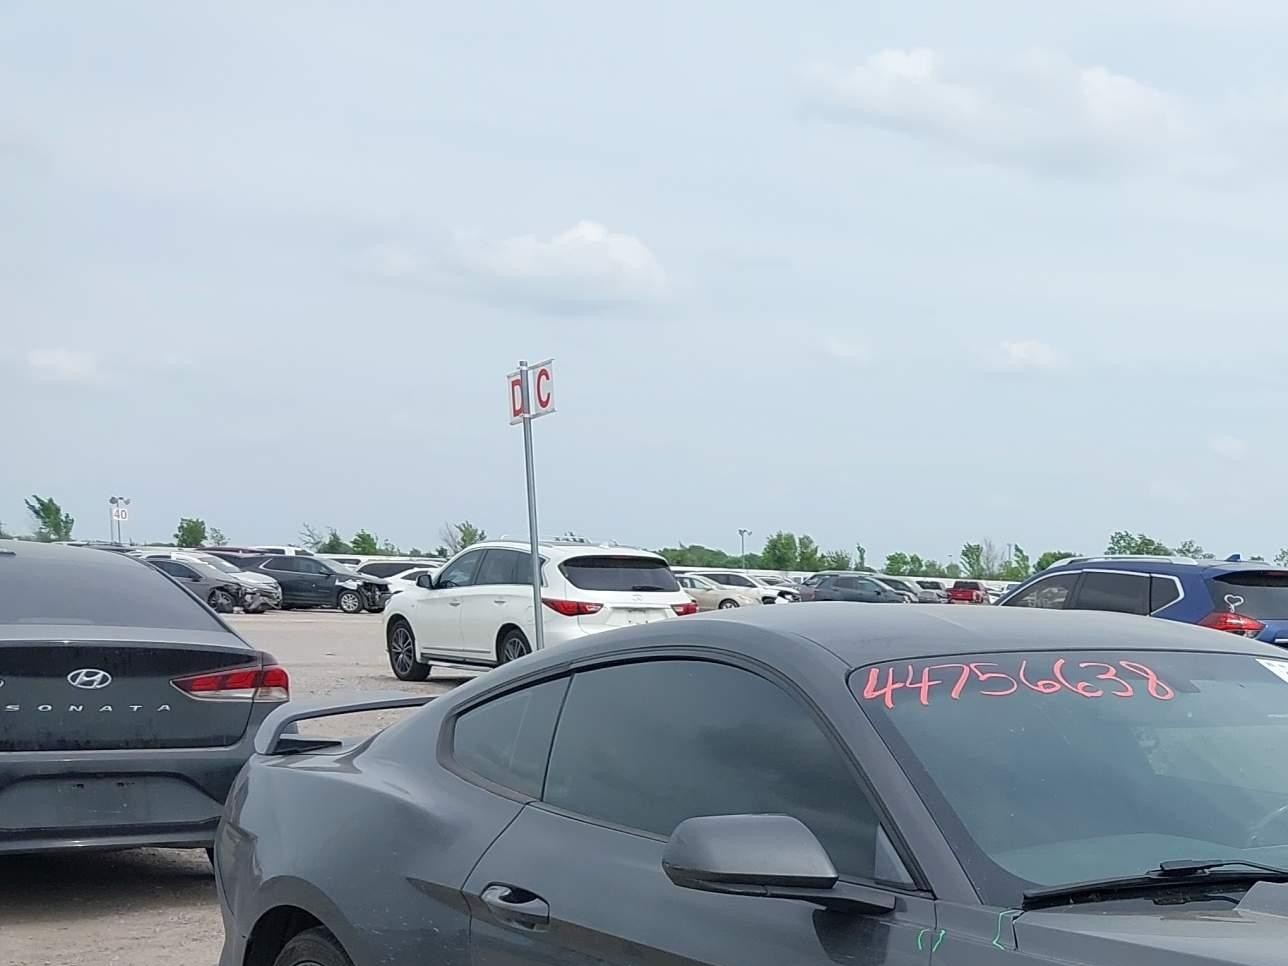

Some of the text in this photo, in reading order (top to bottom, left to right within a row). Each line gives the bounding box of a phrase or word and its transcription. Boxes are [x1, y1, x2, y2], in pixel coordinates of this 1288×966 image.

[536, 368, 551, 409] C
[113, 509, 127, 520] 40
[862, 658, 1176, 710] 44756638
[4, 704, 172, 713] SONATA
